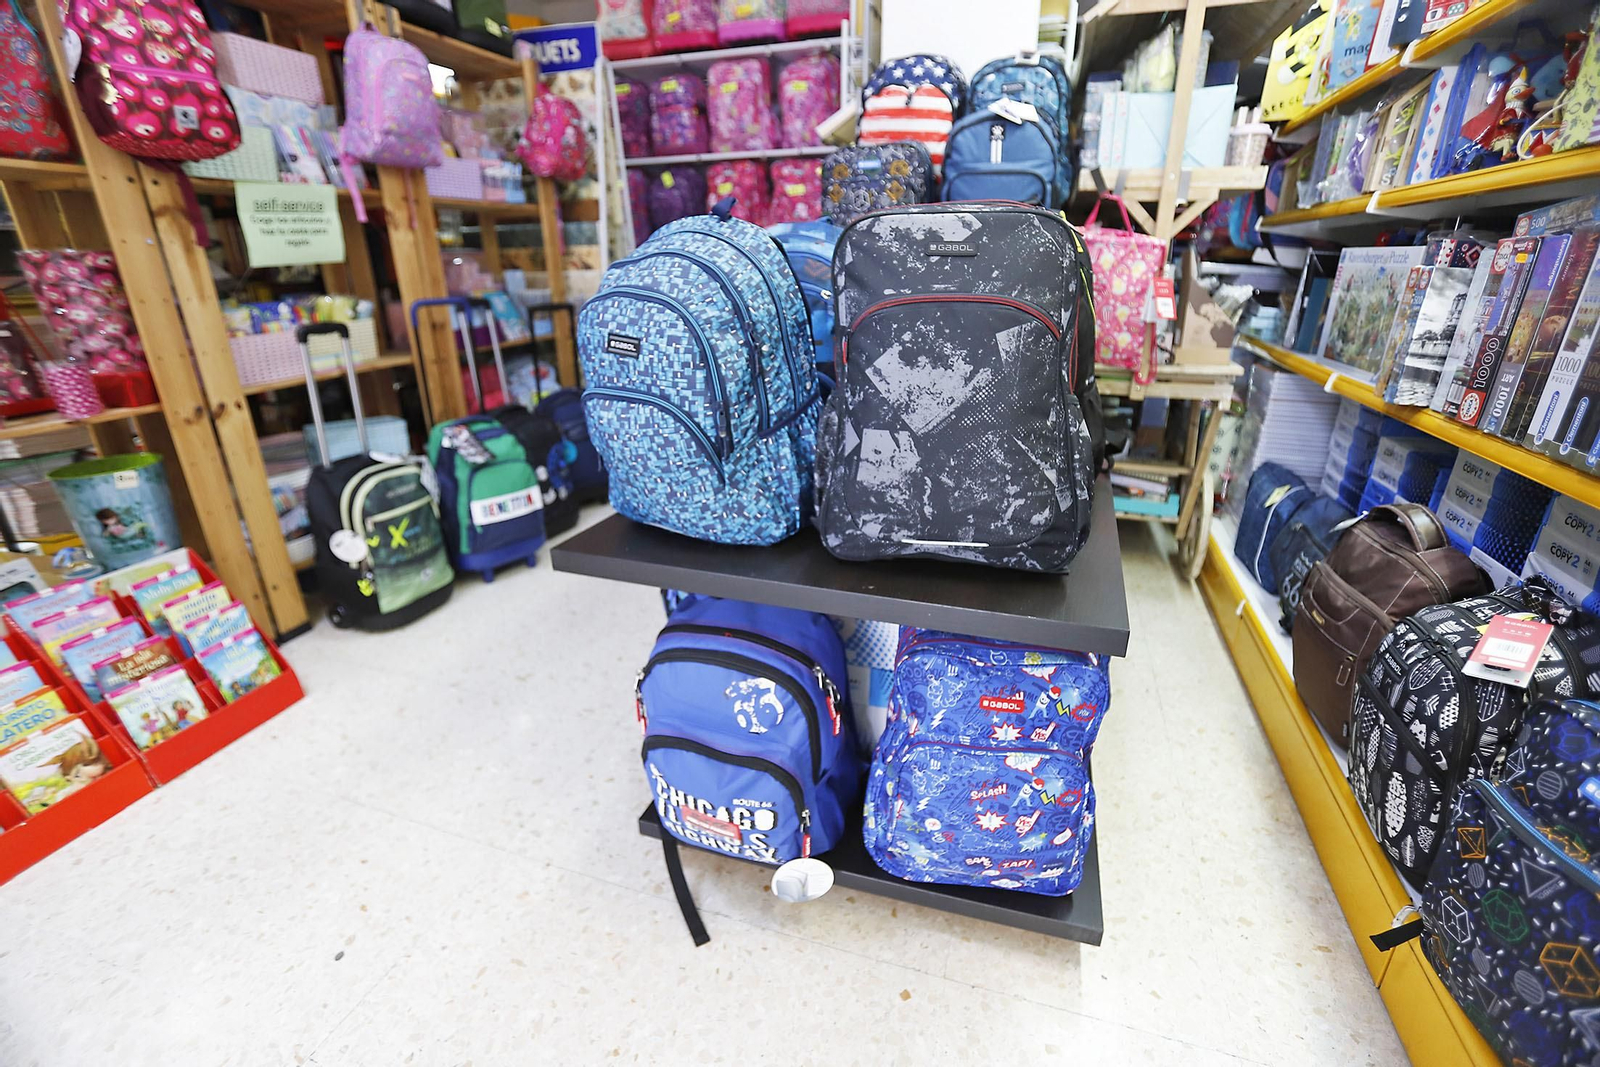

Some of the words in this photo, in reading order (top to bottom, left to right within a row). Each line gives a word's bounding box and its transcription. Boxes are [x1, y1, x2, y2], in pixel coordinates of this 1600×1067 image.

[533, 38, 581, 65] UETS
[1530, 217, 1546, 230] 500
[938, 244, 974, 252] GABOL
[1547, 238, 1568, 288] Ravensburger
[1473, 337, 1500, 389] 1000
[1556, 356, 1581, 374] 1000
[1493, 385, 1511, 417] 1000
[1540, 393, 1559, 433] Clementoni
[1566, 400, 1586, 442] Clementoni
[990, 700, 1021, 711] GABOL
[970, 783, 1007, 800] SPLASH
[656, 775, 778, 832] CHICAGO
[732, 798, 761, 808] ROUTE
[1002, 859, 1033, 874] ZAP!
